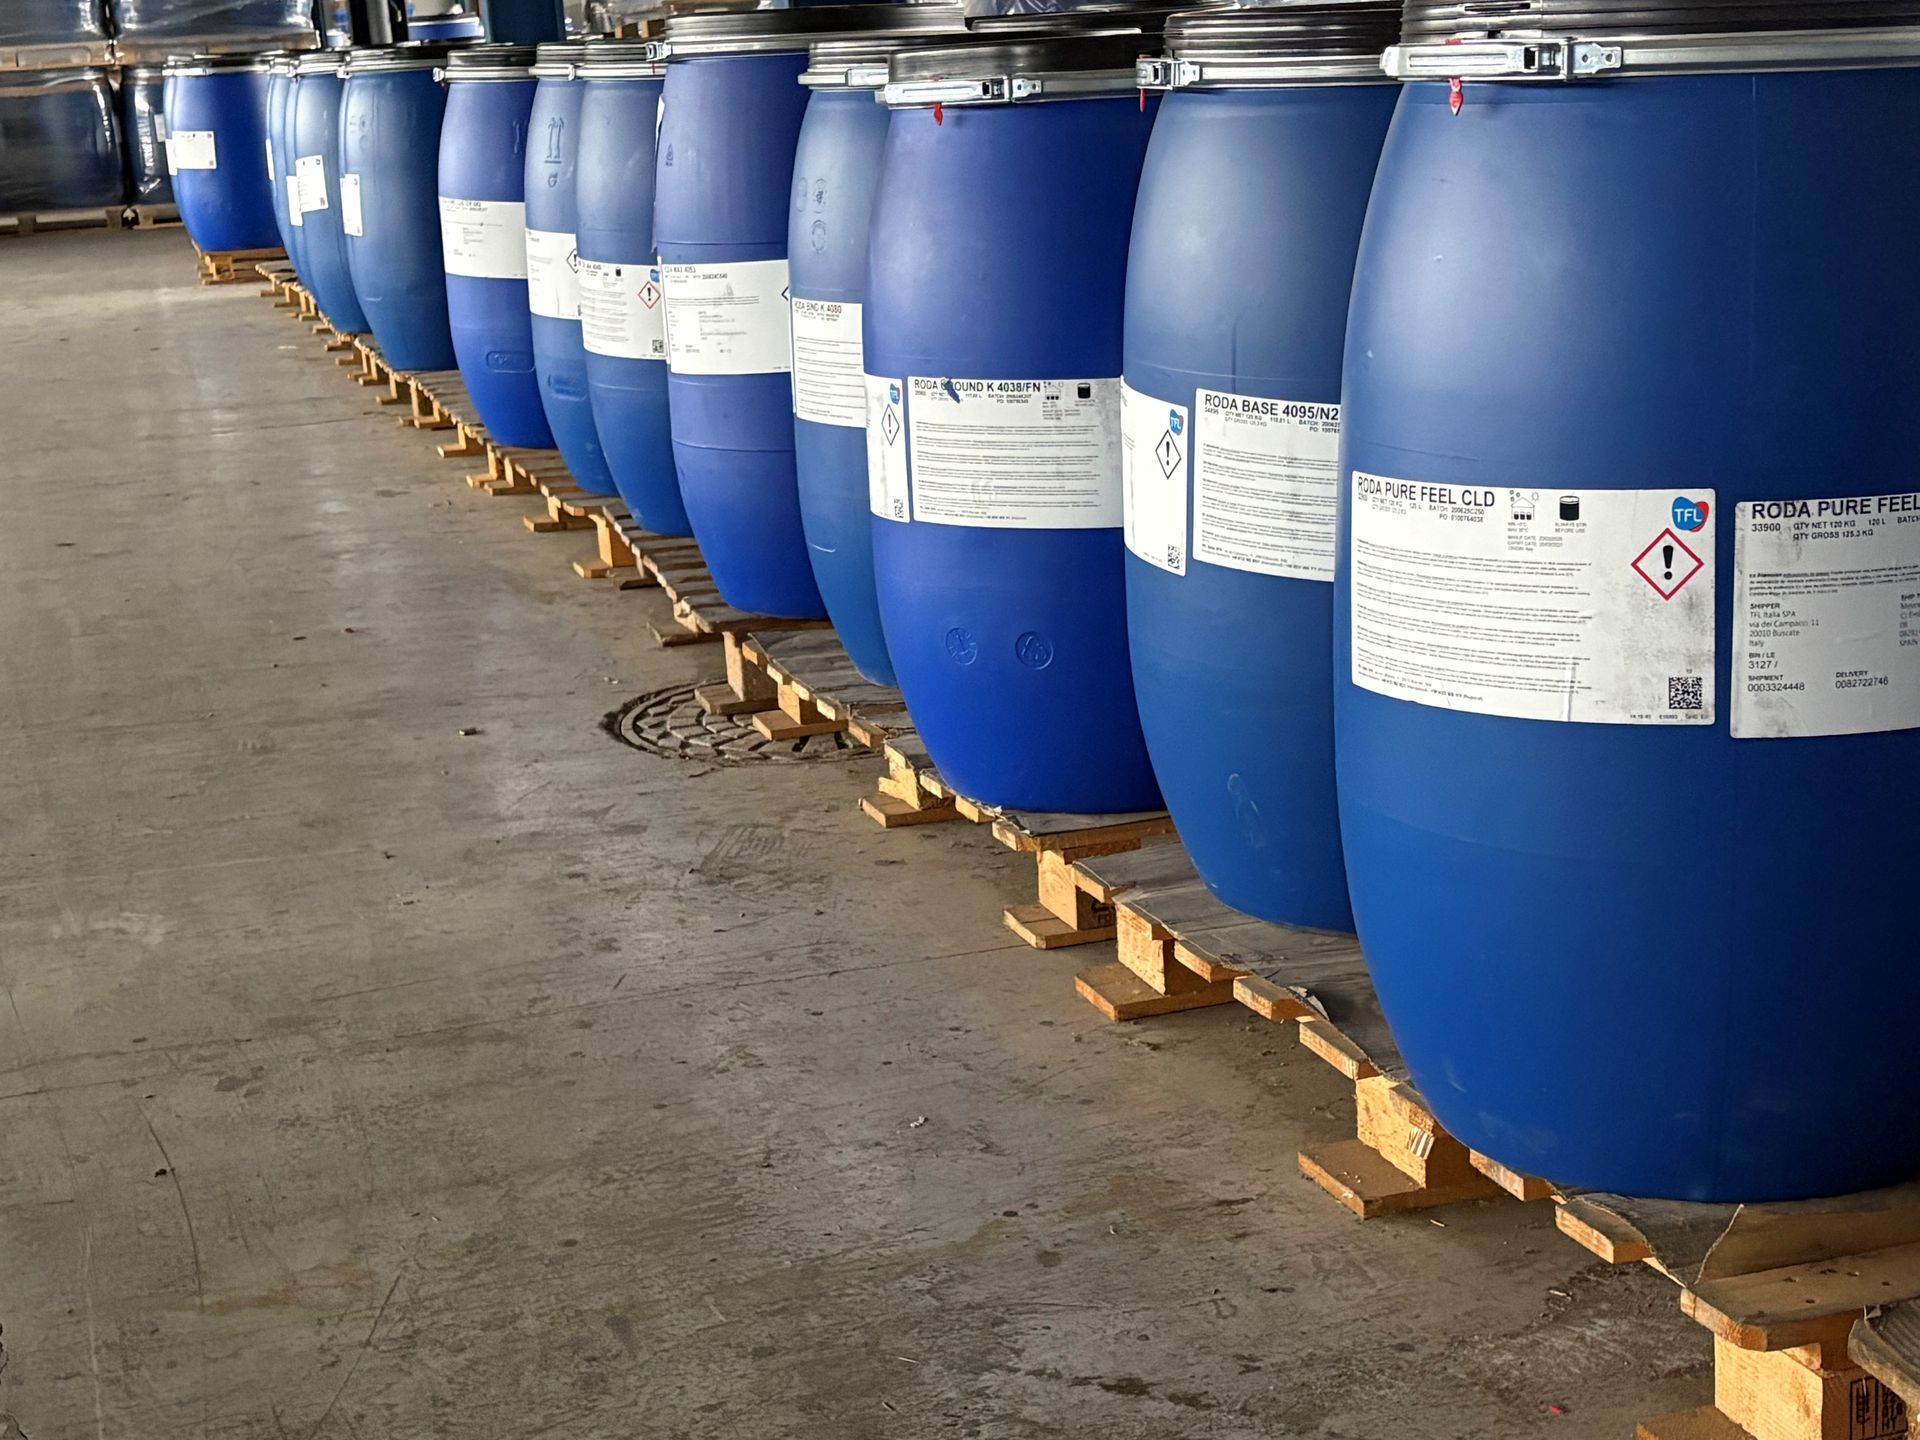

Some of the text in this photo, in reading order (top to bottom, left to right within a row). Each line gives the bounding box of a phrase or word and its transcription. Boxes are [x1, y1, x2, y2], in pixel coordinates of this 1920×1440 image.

[914, 379, 1041, 393] RODA GOUND K 4038/FN
[1204, 394, 1339, 421] RODA BASE 4095/N2
[1358, 476, 1382, 496] RODA
[1385, 482, 1416, 501] PURE
[1421, 486, 1456, 504] FEEL
[1462, 489, 1495, 507] CLD
[1752, 494, 1920, 520] RODA PURE FEEL
[1674, 508, 1702, 523] TFL
[1752, 523, 1781, 532] 33900
[1793, 522, 1810, 531] QTY
[1811, 522, 1827, 530] NET
[1830, 520, 1842, 528] 120
[1843, 520, 1856, 528] KG
[1868, 518, 1881, 526] 120
[1881, 517, 1886, 525] L
[1793, 532, 1810, 541] QTY
[1811, 531, 1840, 540] GROSS
[1862, 529, 1874, 537] KG
[1750, 602, 1780, 610] SHIPPER
[1749, 630, 1771, 638] 20010
[1748, 660, 1772, 669] 3127
[1836, 670, 1868, 678] DELIVERY
[1747, 682, 1805, 692] 0003324448
